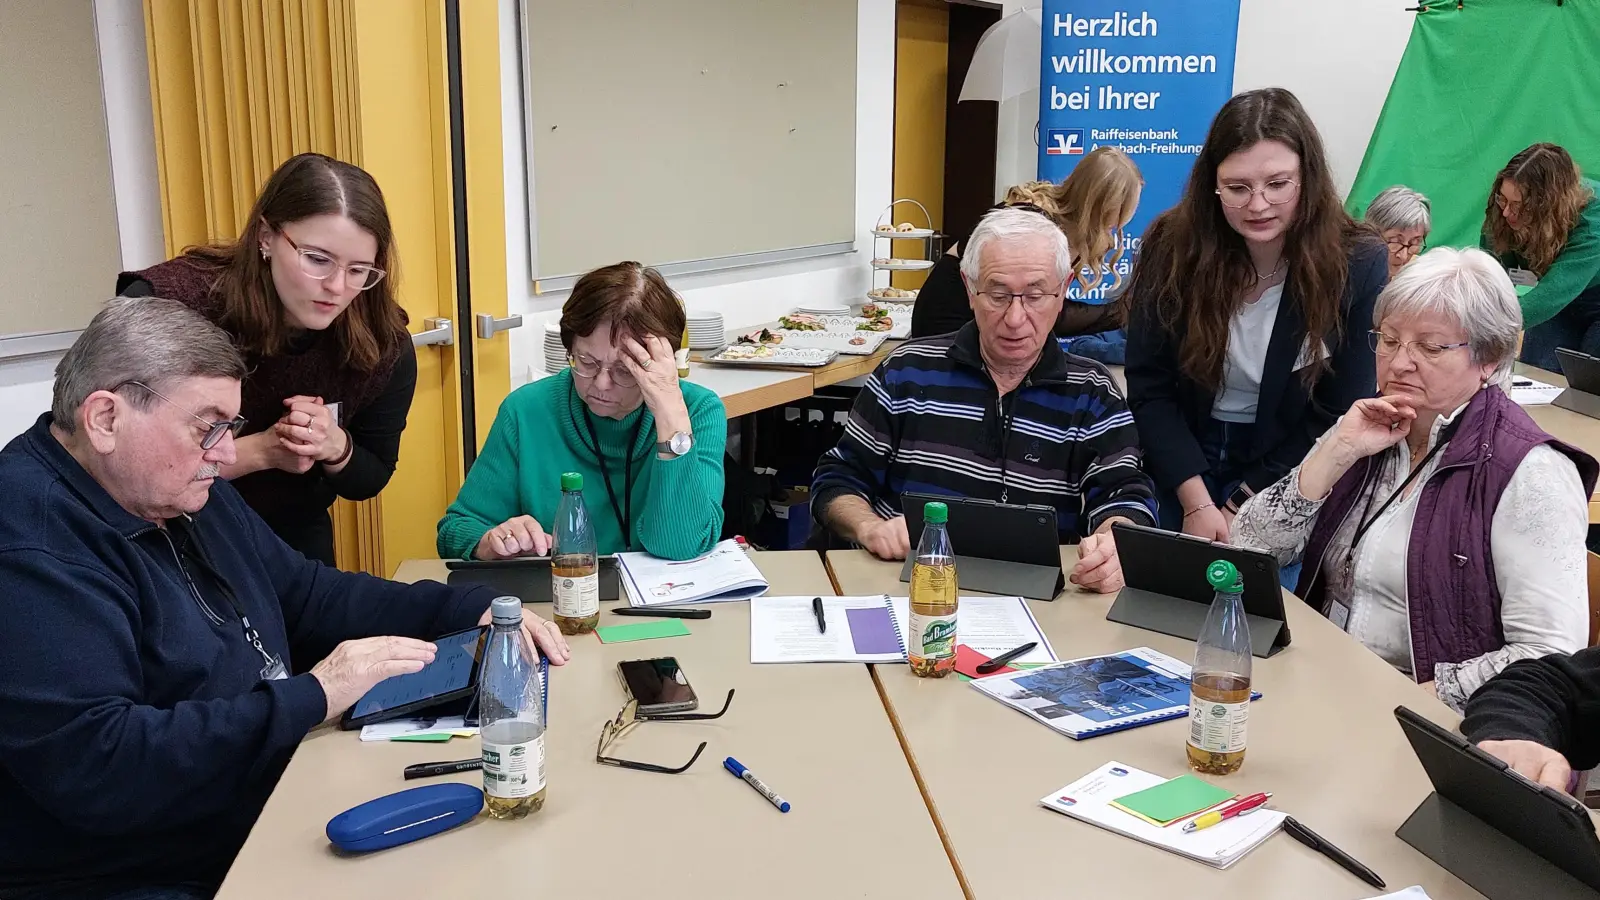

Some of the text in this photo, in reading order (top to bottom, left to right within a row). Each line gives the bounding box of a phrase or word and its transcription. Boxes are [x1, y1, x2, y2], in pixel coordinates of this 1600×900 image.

[1053, 11, 1157, 37] Herzlich
[1051, 48, 1216, 74] willkommen
[1050, 85, 1161, 110] bei Ihrer
[1091, 128, 1179, 140] Raiffeisenbank
[1091, 142, 1204, 157] Abach-Freihung
